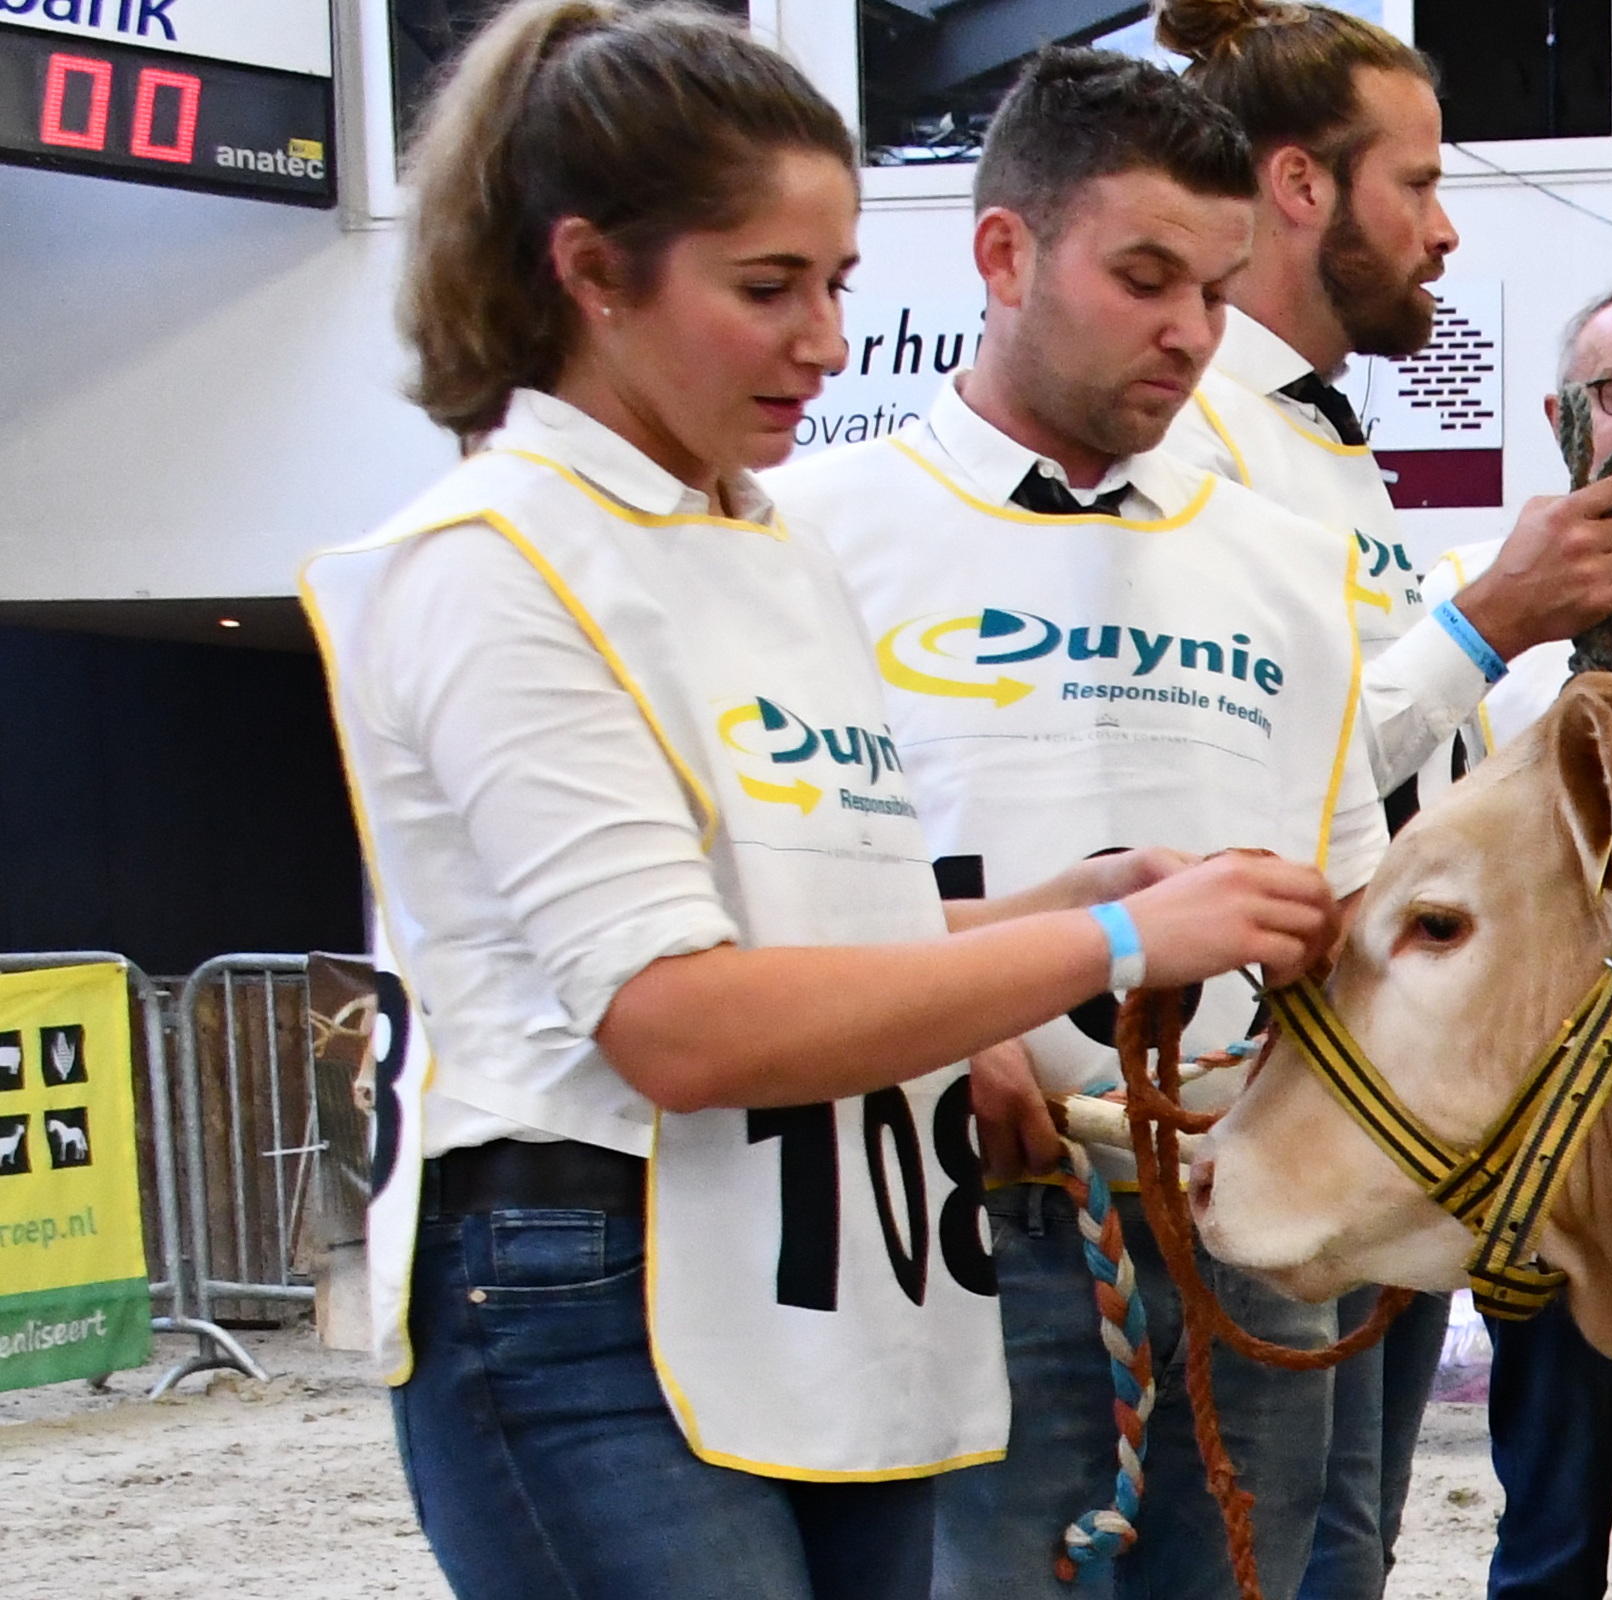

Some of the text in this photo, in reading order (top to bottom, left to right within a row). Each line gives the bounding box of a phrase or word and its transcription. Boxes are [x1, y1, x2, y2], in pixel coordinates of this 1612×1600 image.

[0, 0, 178, 41] ank
[40, 52, 202, 164] 00
[216, 145, 325, 180] anatec
[975, 608, 1284, 697] Duynie
[1062, 682, 1210, 709] Responsible
